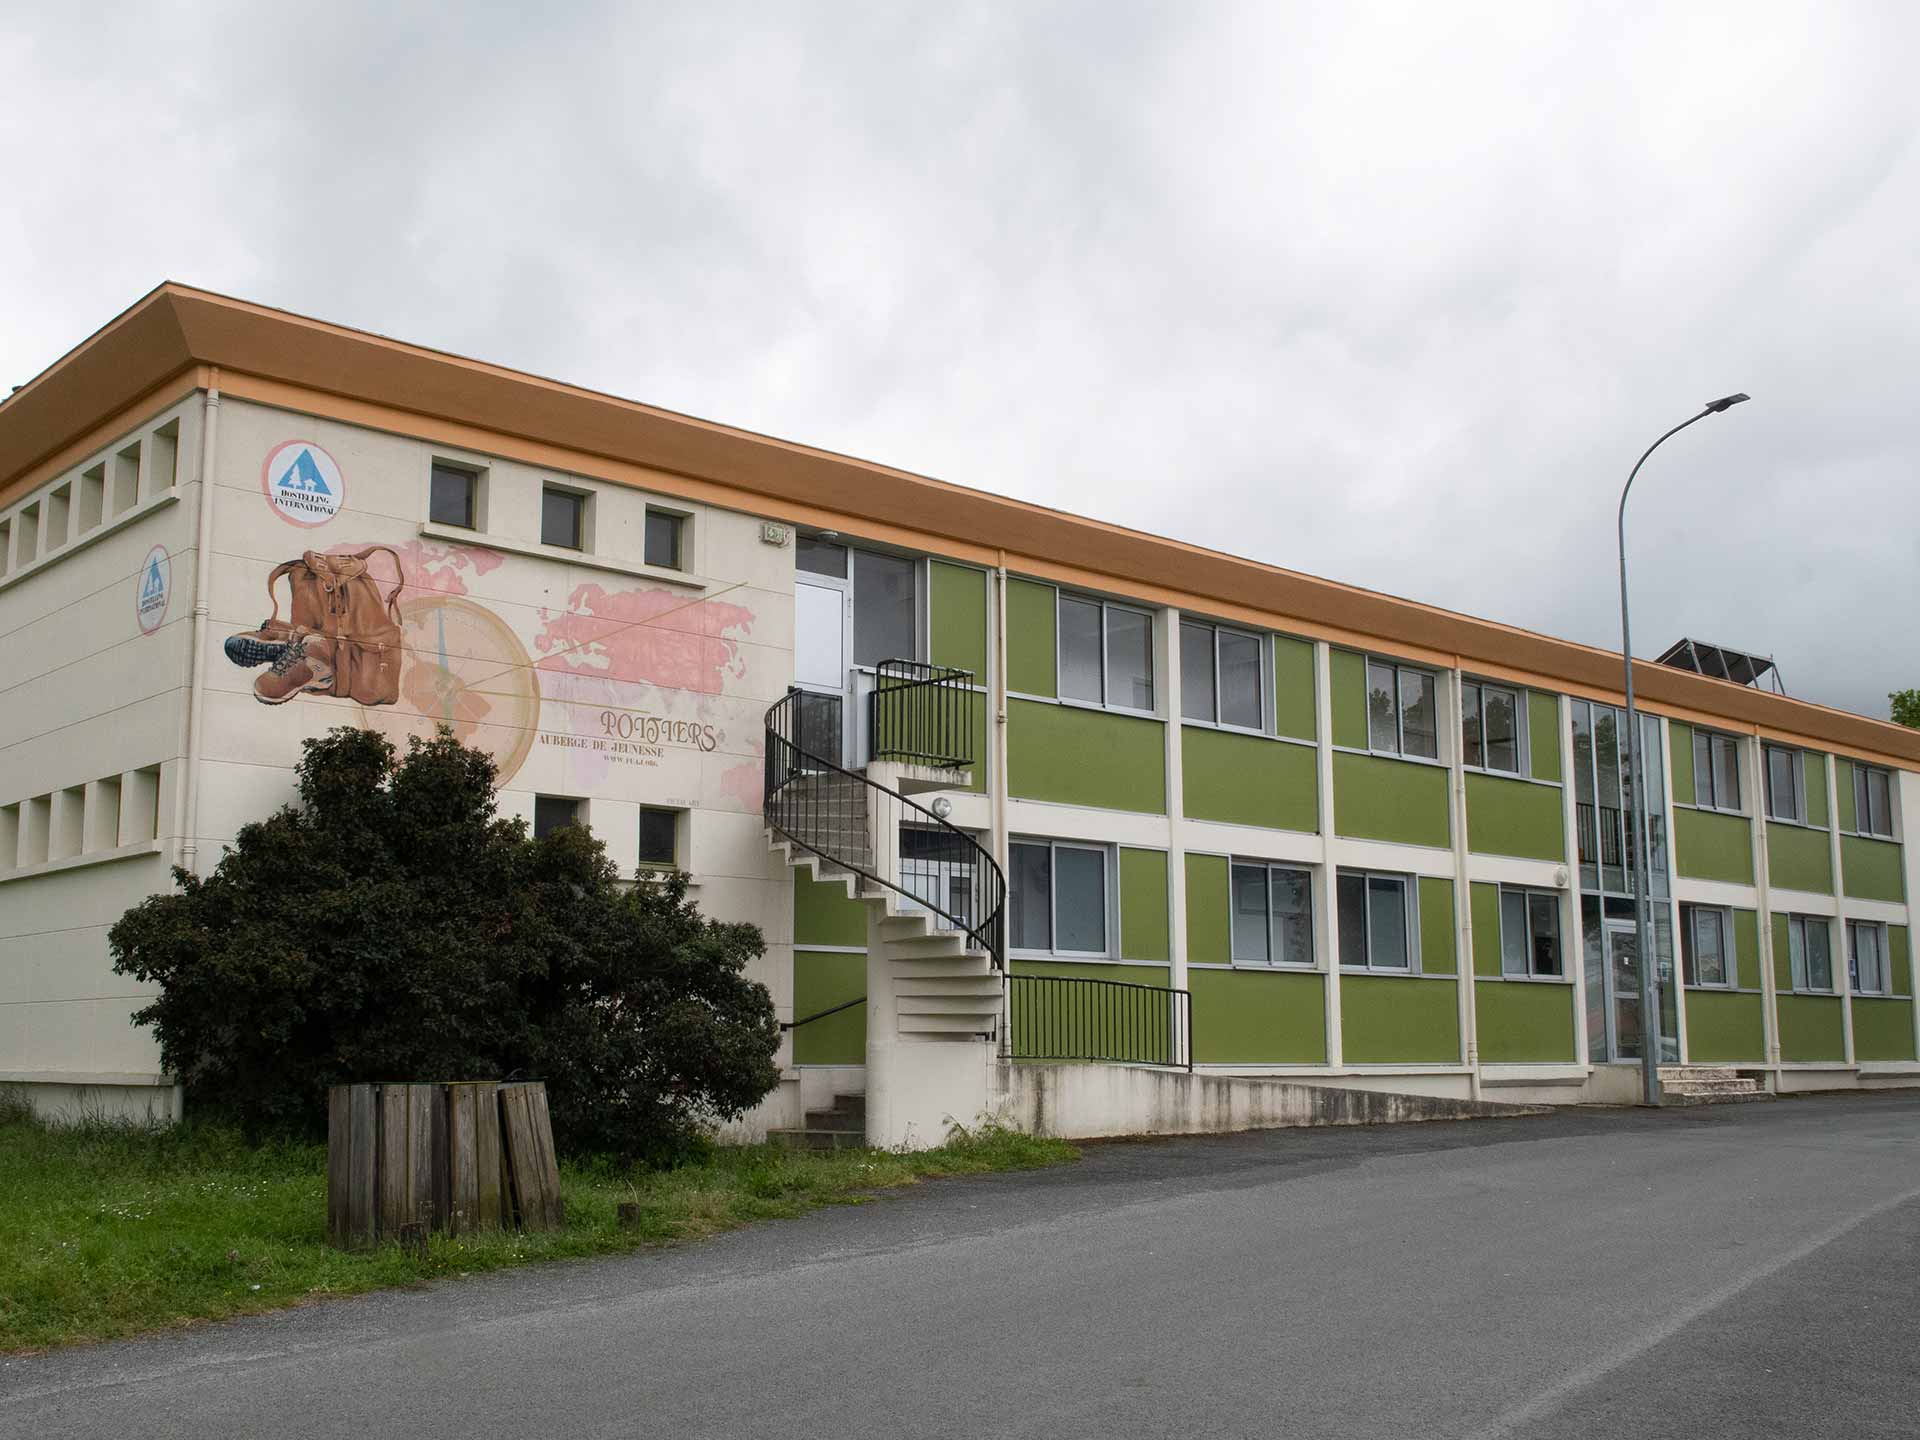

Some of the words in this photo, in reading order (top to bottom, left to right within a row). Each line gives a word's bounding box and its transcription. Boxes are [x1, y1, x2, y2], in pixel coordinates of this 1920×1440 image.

[274, 497, 334, 515] INTERNATIONAL
[281, 489, 329, 504] HOSTELLING
[600, 710, 717, 752] POITIERS
[539, 734, 588, 749] AUBERGE
[592, 740, 607, 751] DE
[611, 742, 664, 758] JEUNESSE
